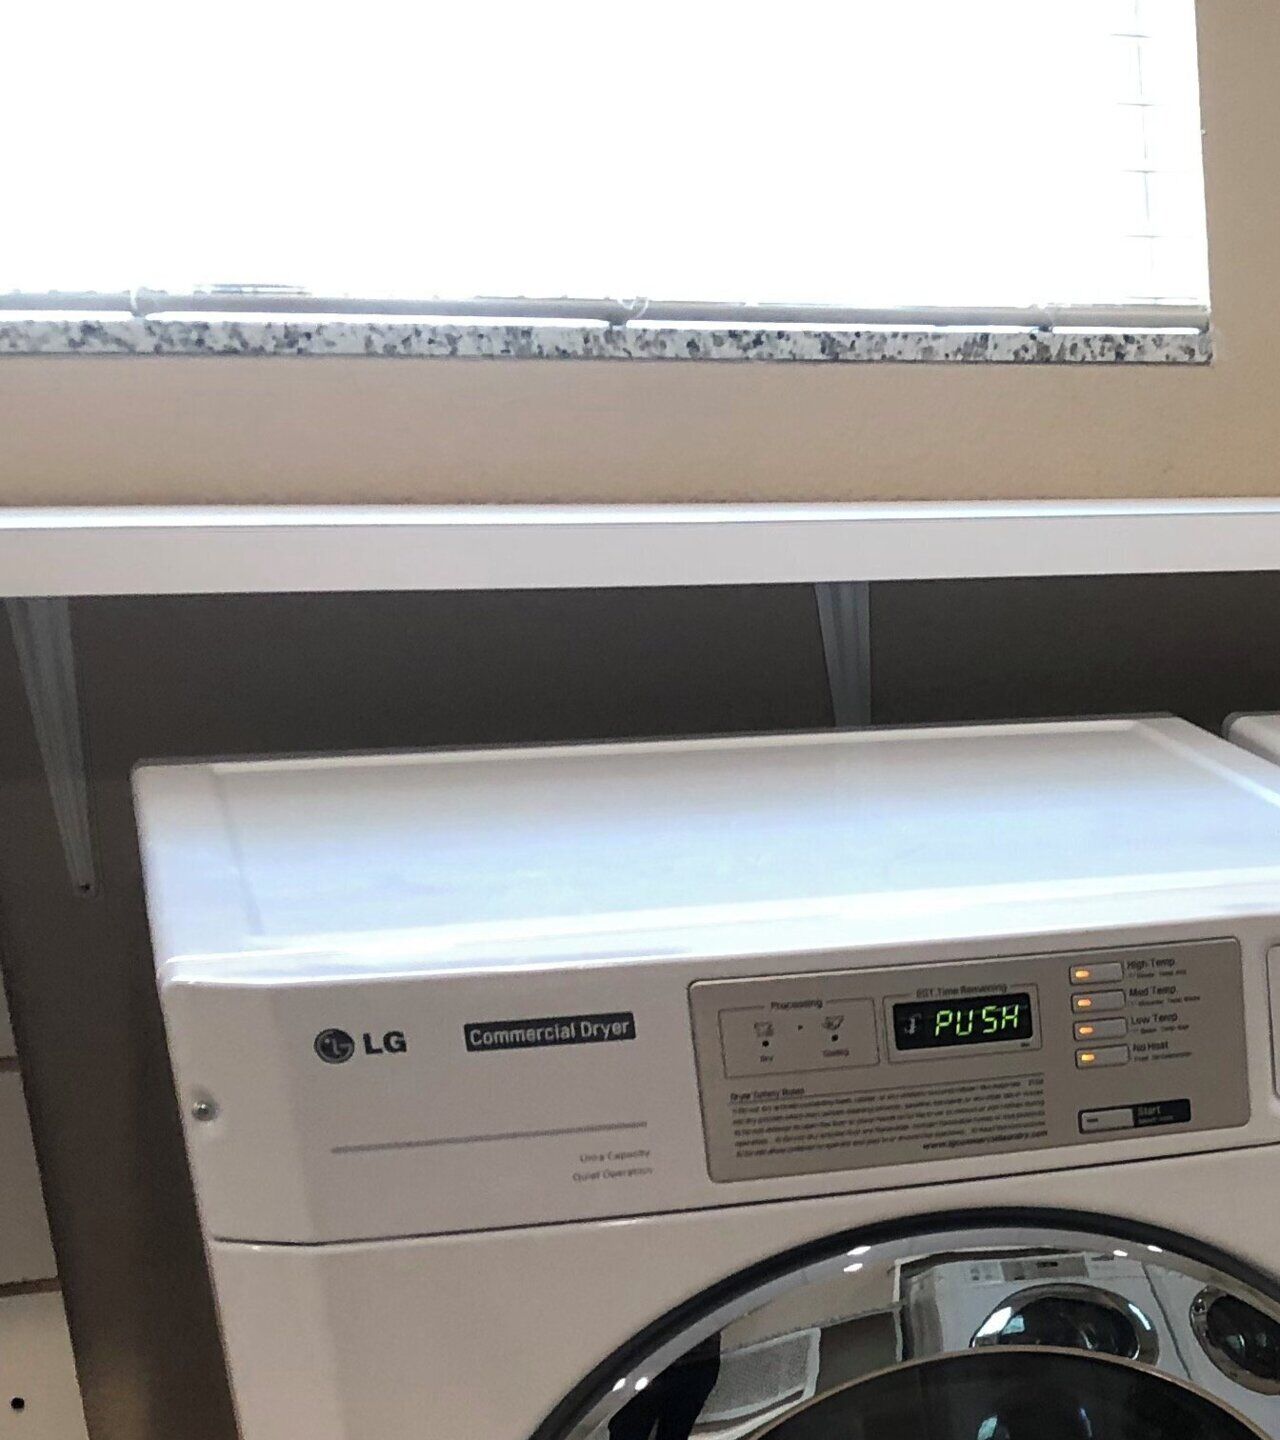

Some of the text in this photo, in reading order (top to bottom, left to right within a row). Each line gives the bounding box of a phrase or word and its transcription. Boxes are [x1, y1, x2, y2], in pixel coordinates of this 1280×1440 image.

[1151, 957, 1176, 969] Temp
[1151, 984, 1177, 996] Temp
[935, 1004, 1019, 1037] PUSH
[1152, 1012, 1178, 1024] Temp
[469, 1018, 630, 1047] Commercial Dryer
[363, 1031, 407, 1055] LG
